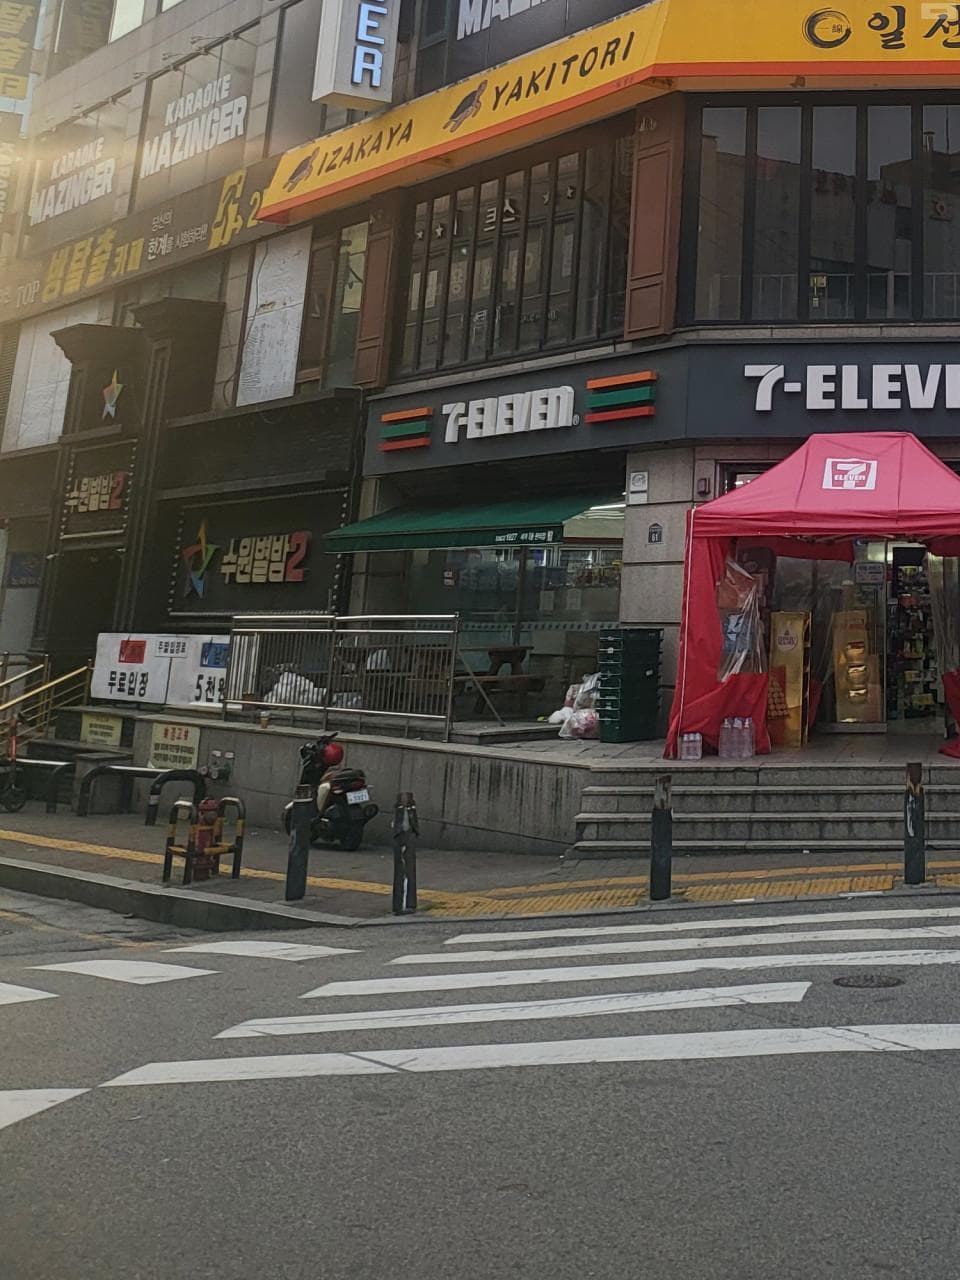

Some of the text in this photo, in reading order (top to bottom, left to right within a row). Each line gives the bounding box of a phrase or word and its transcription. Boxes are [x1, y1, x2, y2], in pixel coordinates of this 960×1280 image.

[492, 31, 636, 112] YAKITORI
[163, 73, 233, 127] KARAOKE
[51, 137, 105, 180] KARAOKE
[139, 96, 249, 180] MAZINGER
[317, 119, 415, 176] IZAKAYA
[30, 158, 116, 227] MAZINGER
[16, 280, 40, 309] TOP
[221, 531, 311, 584] 수원별밤2
